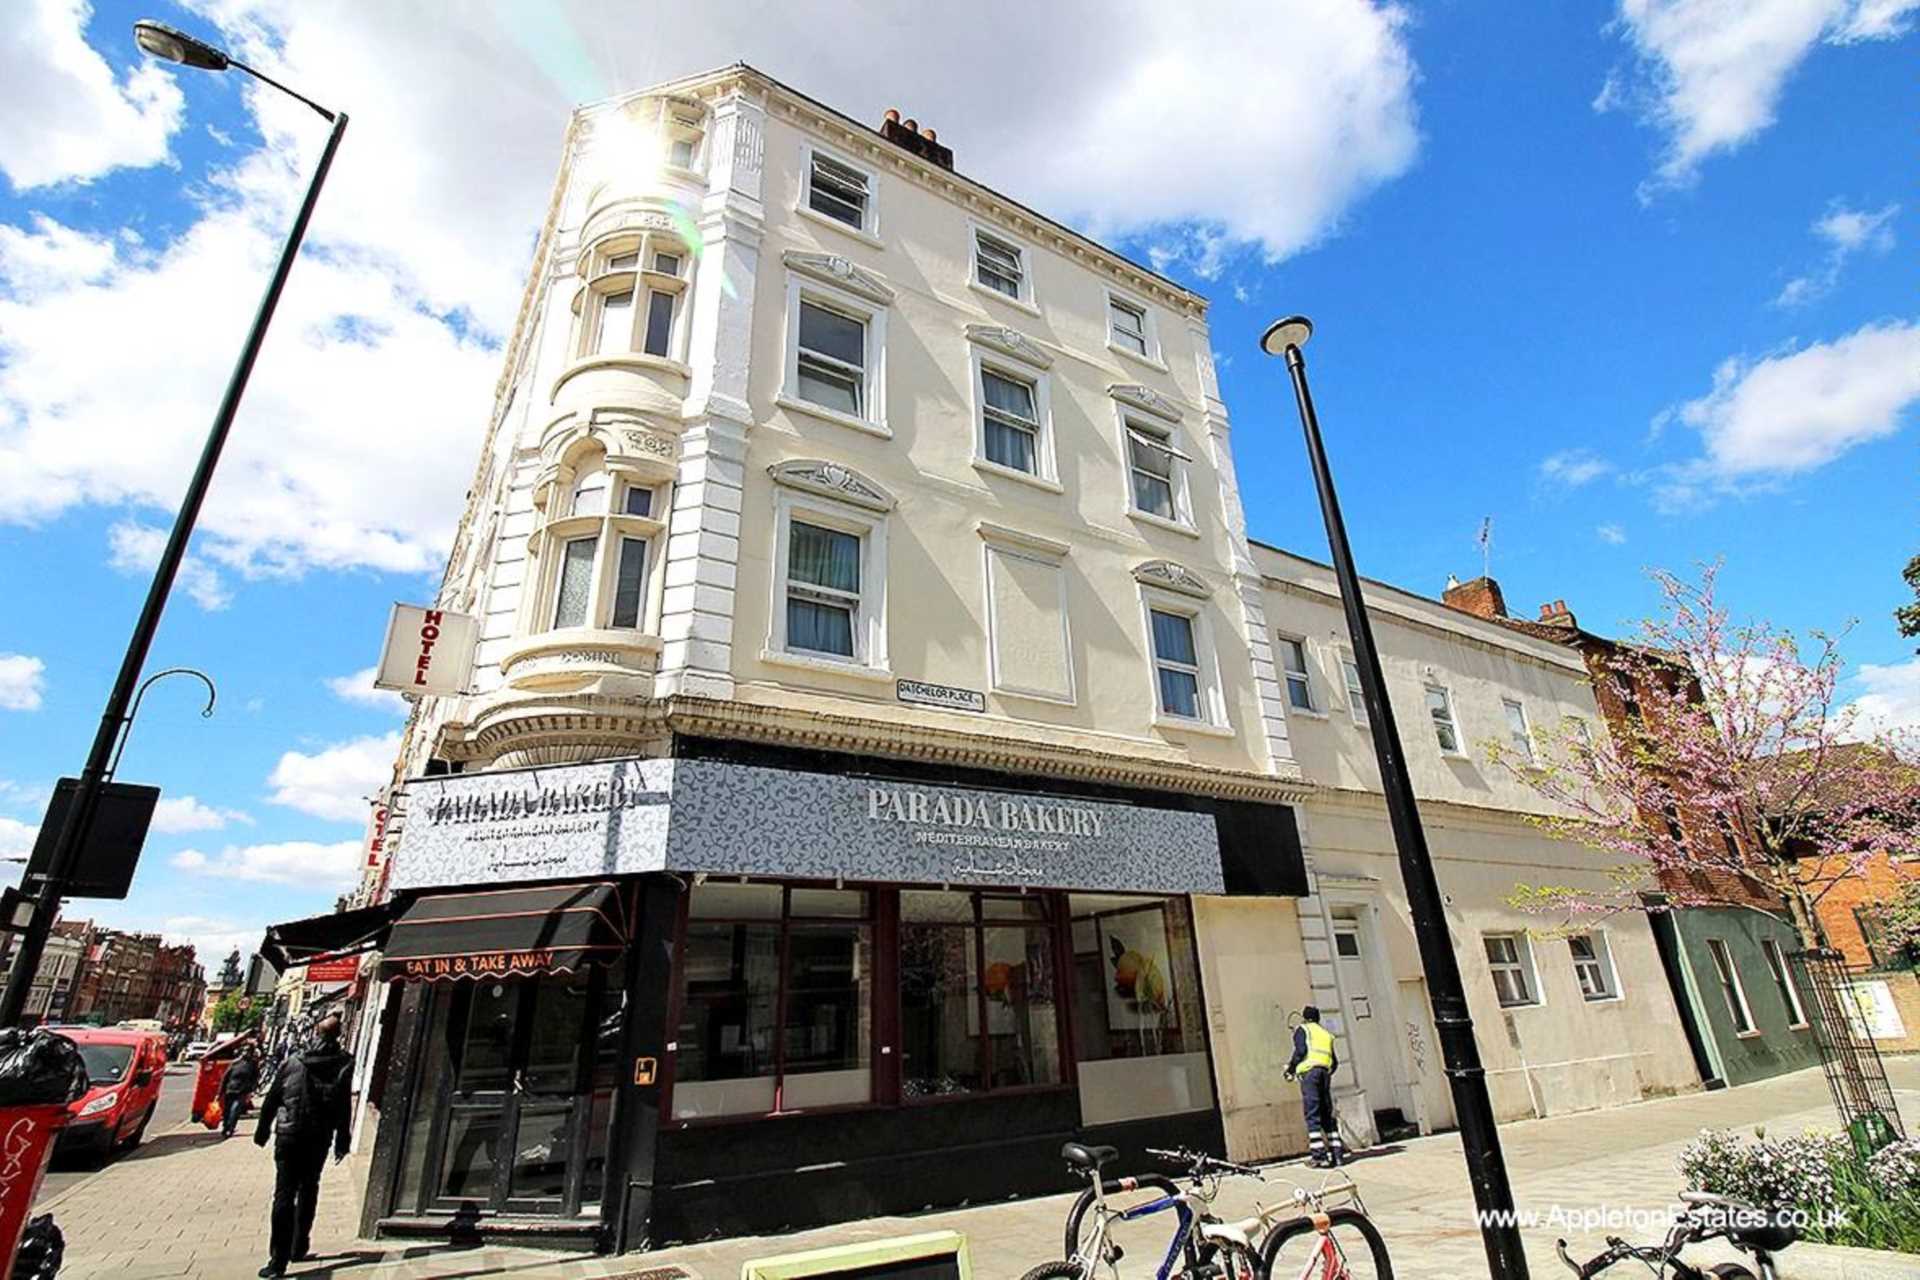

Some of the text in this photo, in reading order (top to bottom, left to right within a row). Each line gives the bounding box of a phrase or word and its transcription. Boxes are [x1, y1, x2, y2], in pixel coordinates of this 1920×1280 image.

[415, 610, 443, 685] HOTEL
[867, 788, 1105, 837] PARADA BAKERY
[407, 953, 553, 973] EAT IN & TAKE AWAY
